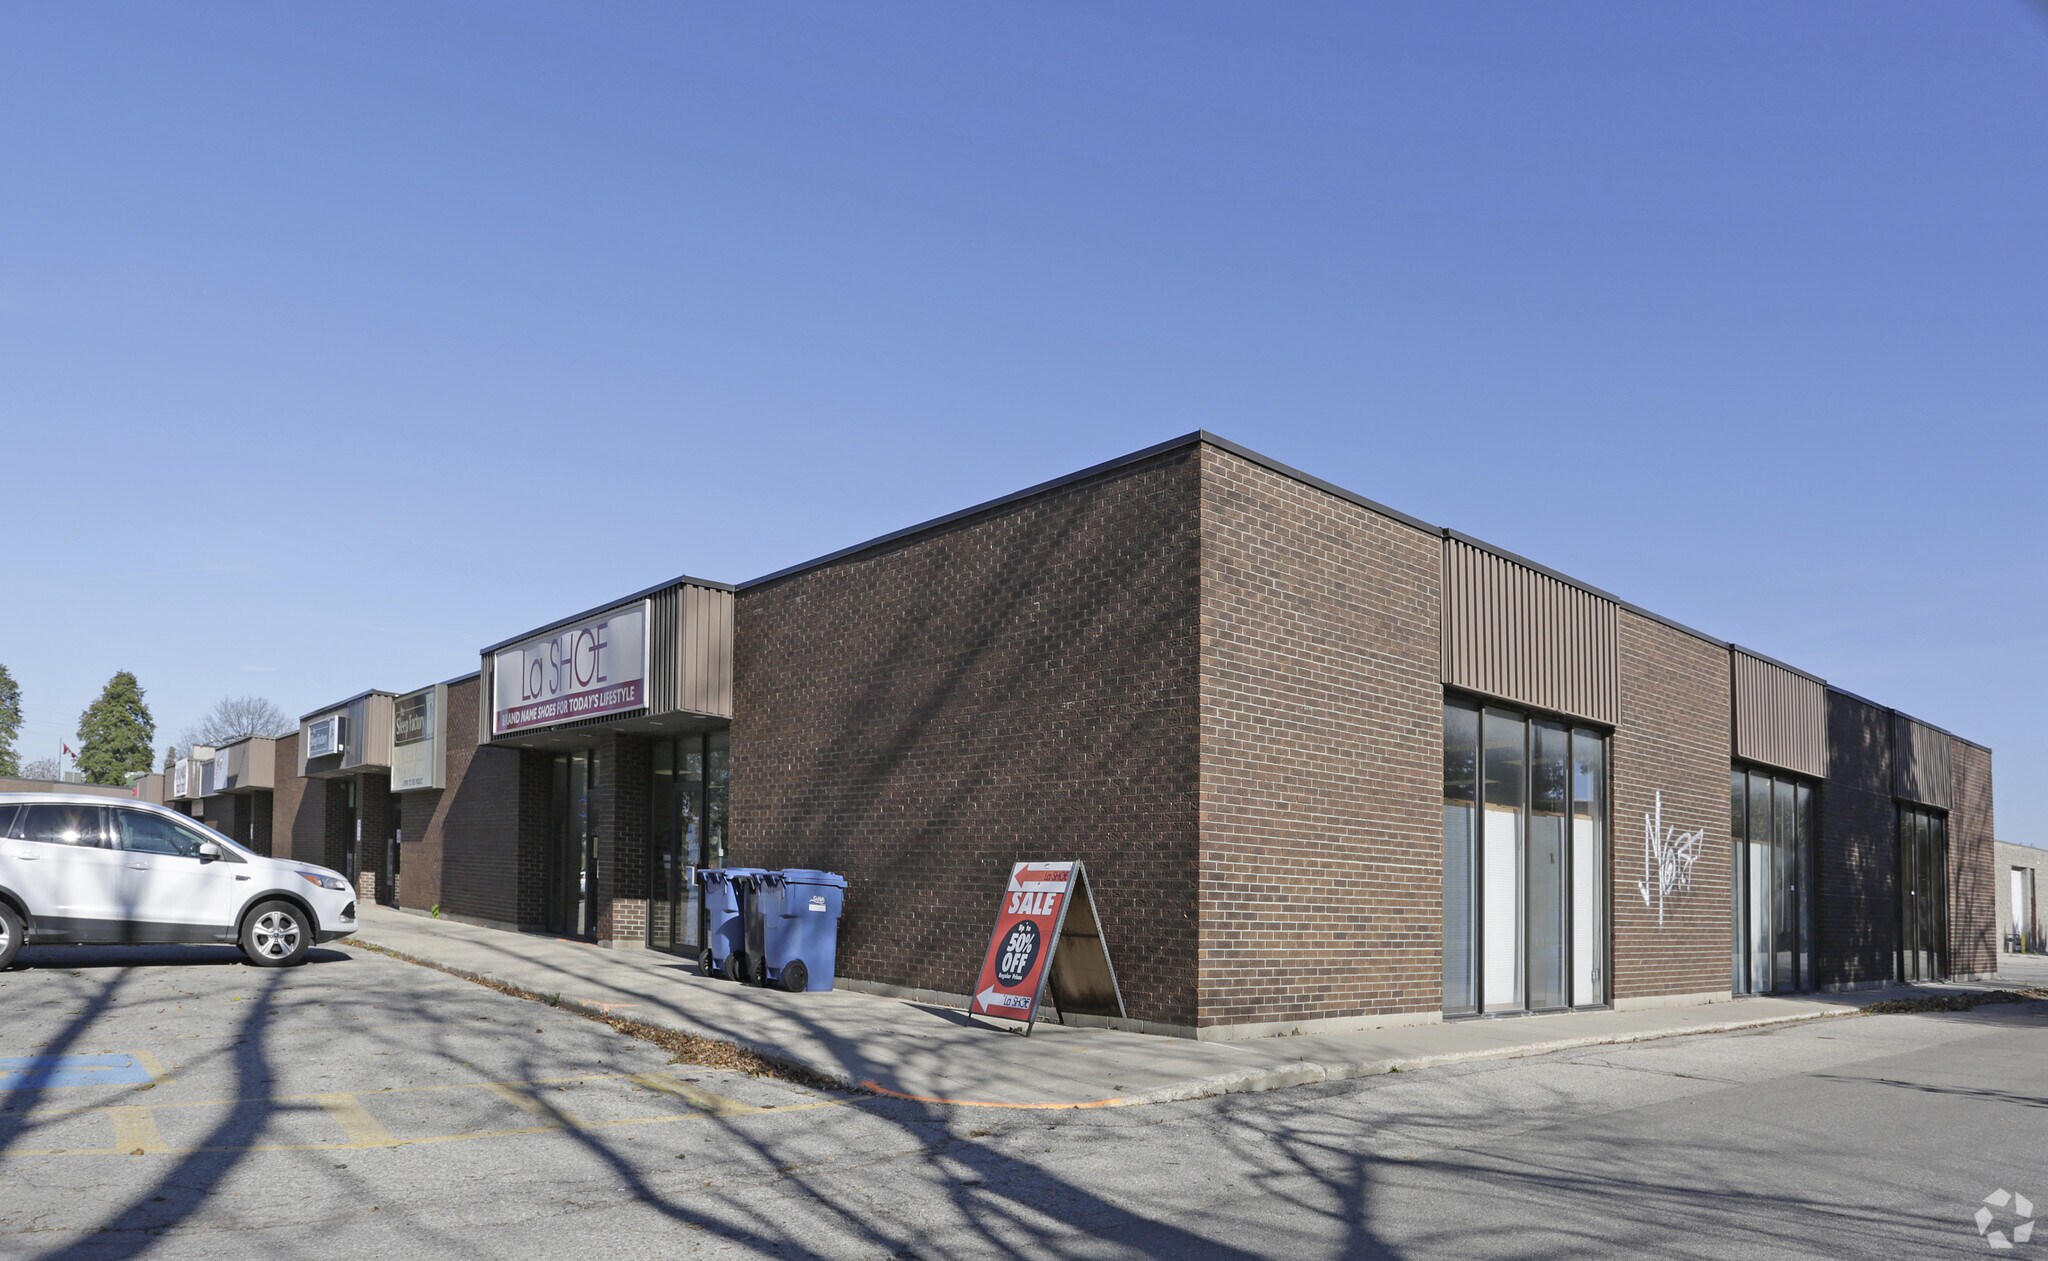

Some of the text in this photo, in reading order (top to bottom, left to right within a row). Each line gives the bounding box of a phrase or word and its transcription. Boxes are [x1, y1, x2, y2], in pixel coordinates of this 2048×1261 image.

[522, 621, 609, 701] La SHOE
[521, 707, 537, 723] NAME
[537, 704, 556, 718] SHOES
[556, 701, 569, 715] FOR
[569, 693, 599, 712] TODAY'S
[600, 686, 635, 707] LIFESTYLE
[1007, 892, 1057, 915] SALE
[1006, 932, 1035, 953] 50%
[1001, 952, 1029, 973] OFF
[1011, 996, 1030, 1008] SHOE
